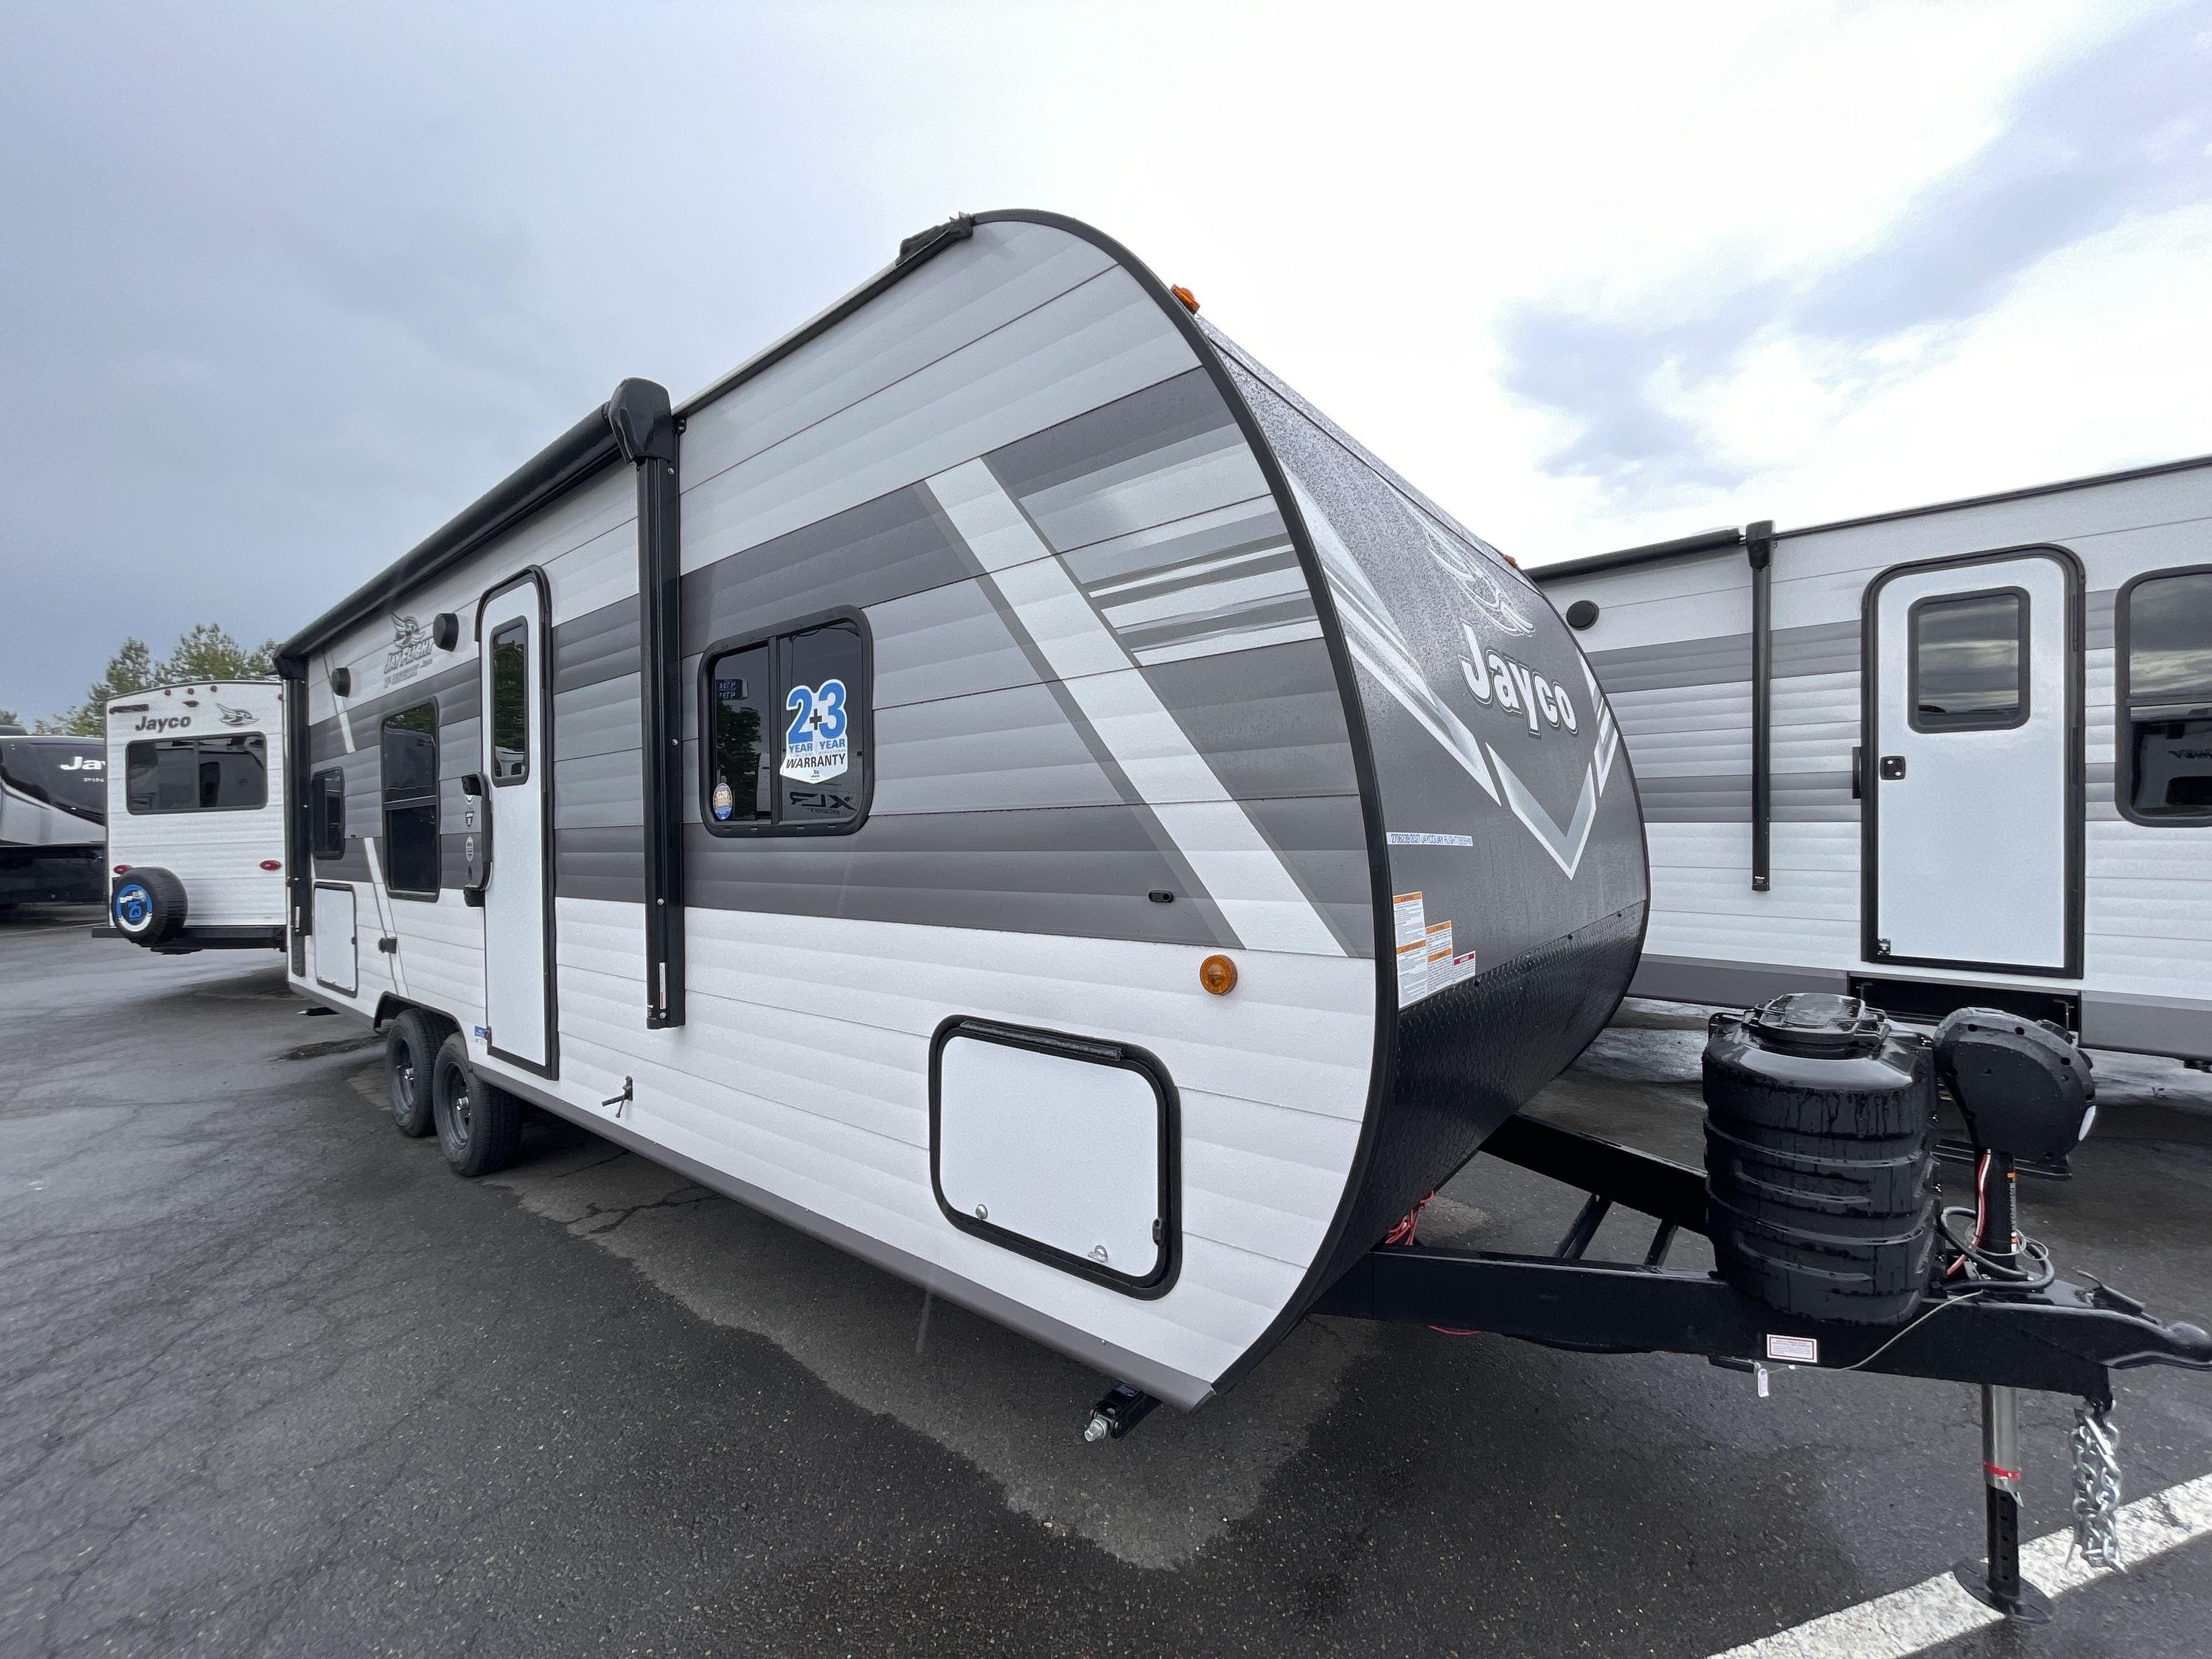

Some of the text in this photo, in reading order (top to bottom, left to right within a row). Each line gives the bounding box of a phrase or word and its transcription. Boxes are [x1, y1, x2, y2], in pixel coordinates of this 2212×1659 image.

[1459, 619, 1577, 736] Jayco
[135, 715, 192, 734] Jayco
[788, 738, 846, 754] YEAR YEAR
[786, 753, 846, 769] WARRANTY
[717, 790, 728, 799] G20
